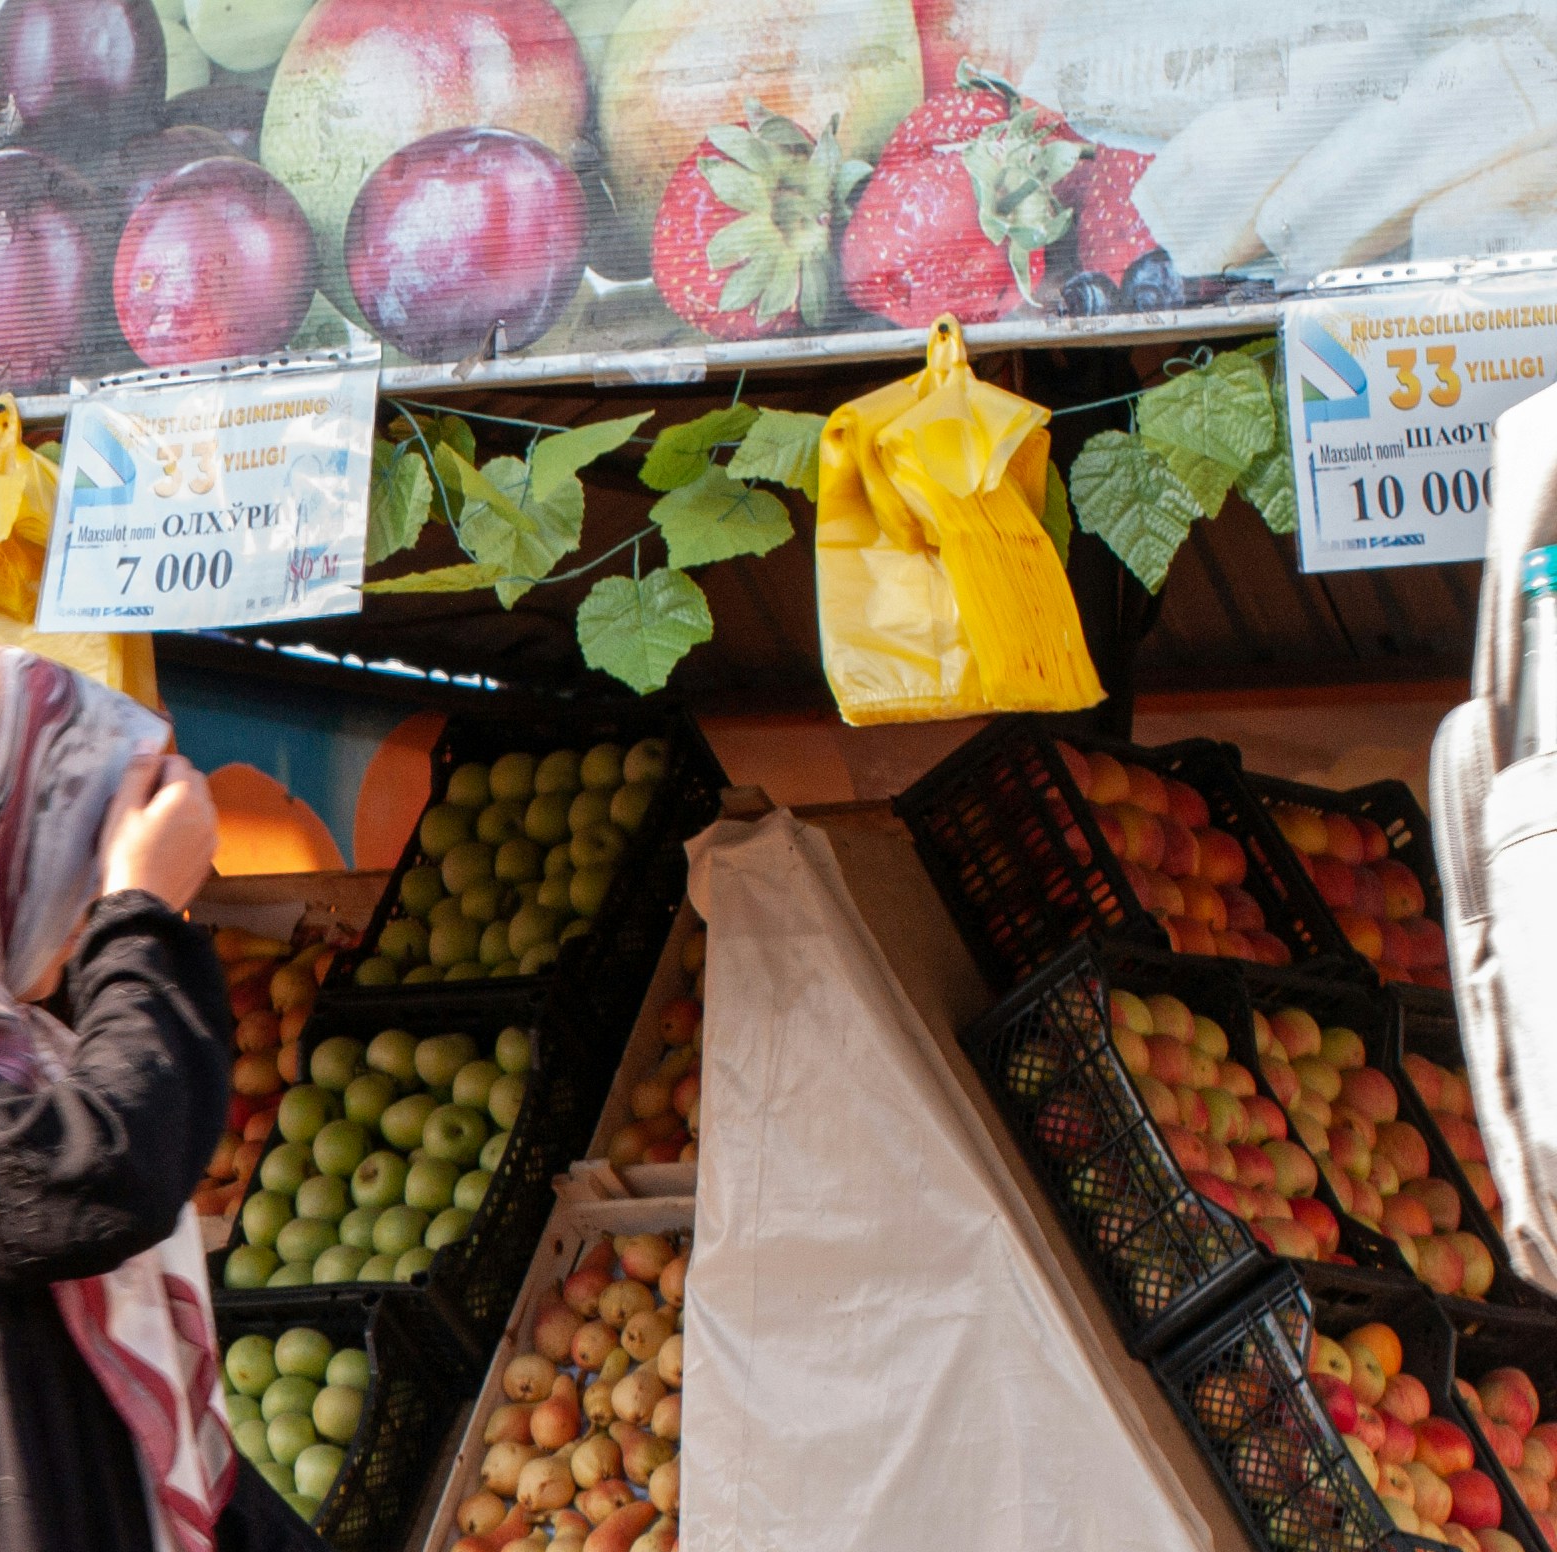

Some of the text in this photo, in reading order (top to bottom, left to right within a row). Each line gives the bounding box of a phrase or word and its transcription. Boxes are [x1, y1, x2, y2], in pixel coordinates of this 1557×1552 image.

[1350, 303, 1557, 342] MUSTAQILLIGIMIZNI
[1386, 345, 1545, 411] 33 YILLIGI
[1320, 438, 1405, 465] Maxsulot nomi
[1404, 421, 1498, 449] ШАФТ
[153, 440, 288, 498] 33 YILLIGI
[1349, 475, 1406, 522] 10
[77, 523, 156, 543] Maxsulot nomi
[162, 502, 281, 537] ОЛХЎРИ
[116, 548, 233, 596] 7 000
